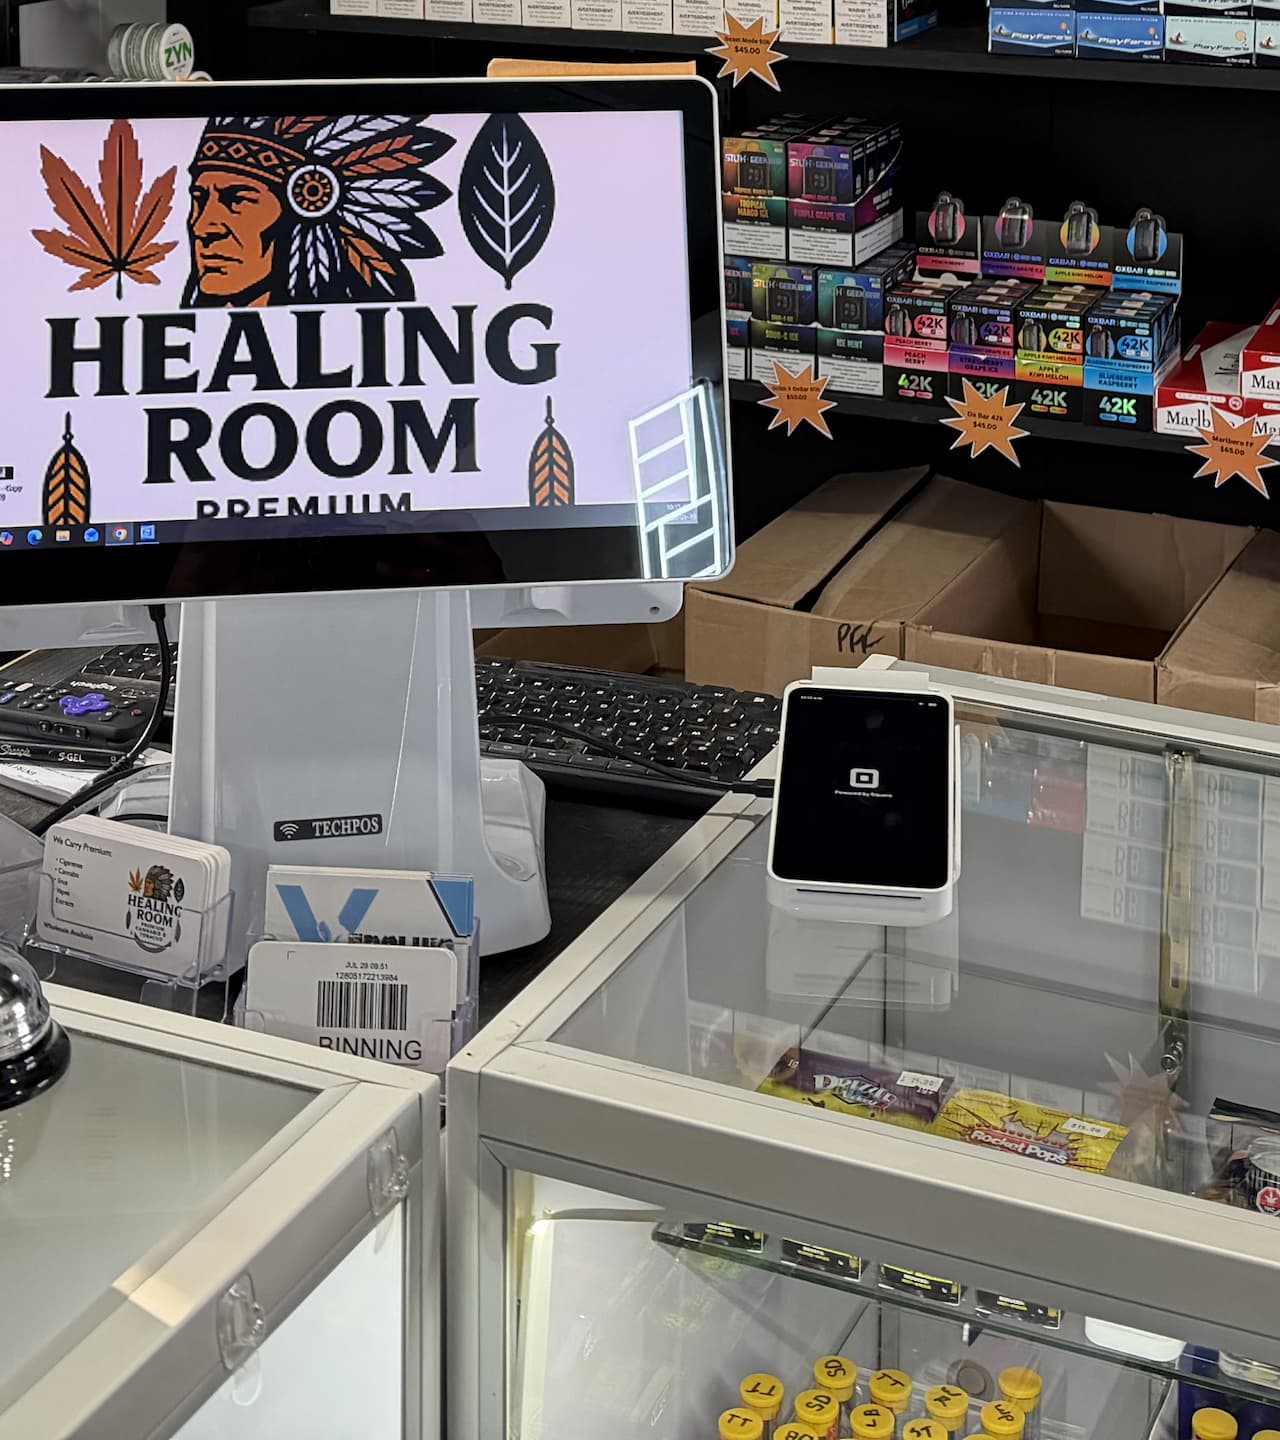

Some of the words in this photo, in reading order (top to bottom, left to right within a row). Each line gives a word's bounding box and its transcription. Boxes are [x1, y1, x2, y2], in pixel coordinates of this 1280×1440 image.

[734, 46, 761, 54] $45.00
[1020, 311, 1047, 320] OXBAR
[44, 303, 561, 399] HEALING
[898, 374, 933, 392] 42K
[1031, 390, 1067, 407] 42K
[1099, 396, 1137, 415] 42K
[143, 397, 482, 484] ROOM
[58, 753, 85, 762] S-GEL
[312, 818, 379, 837] TECHPOS
[65, 839, 82, 851] Carry
[128, 894, 183, 917] HEALING
[137, 910, 173, 927] ROOM
[972, 1129, 1024, 1152] Rocket
[1025, 1141, 1068, 1165] Pops
